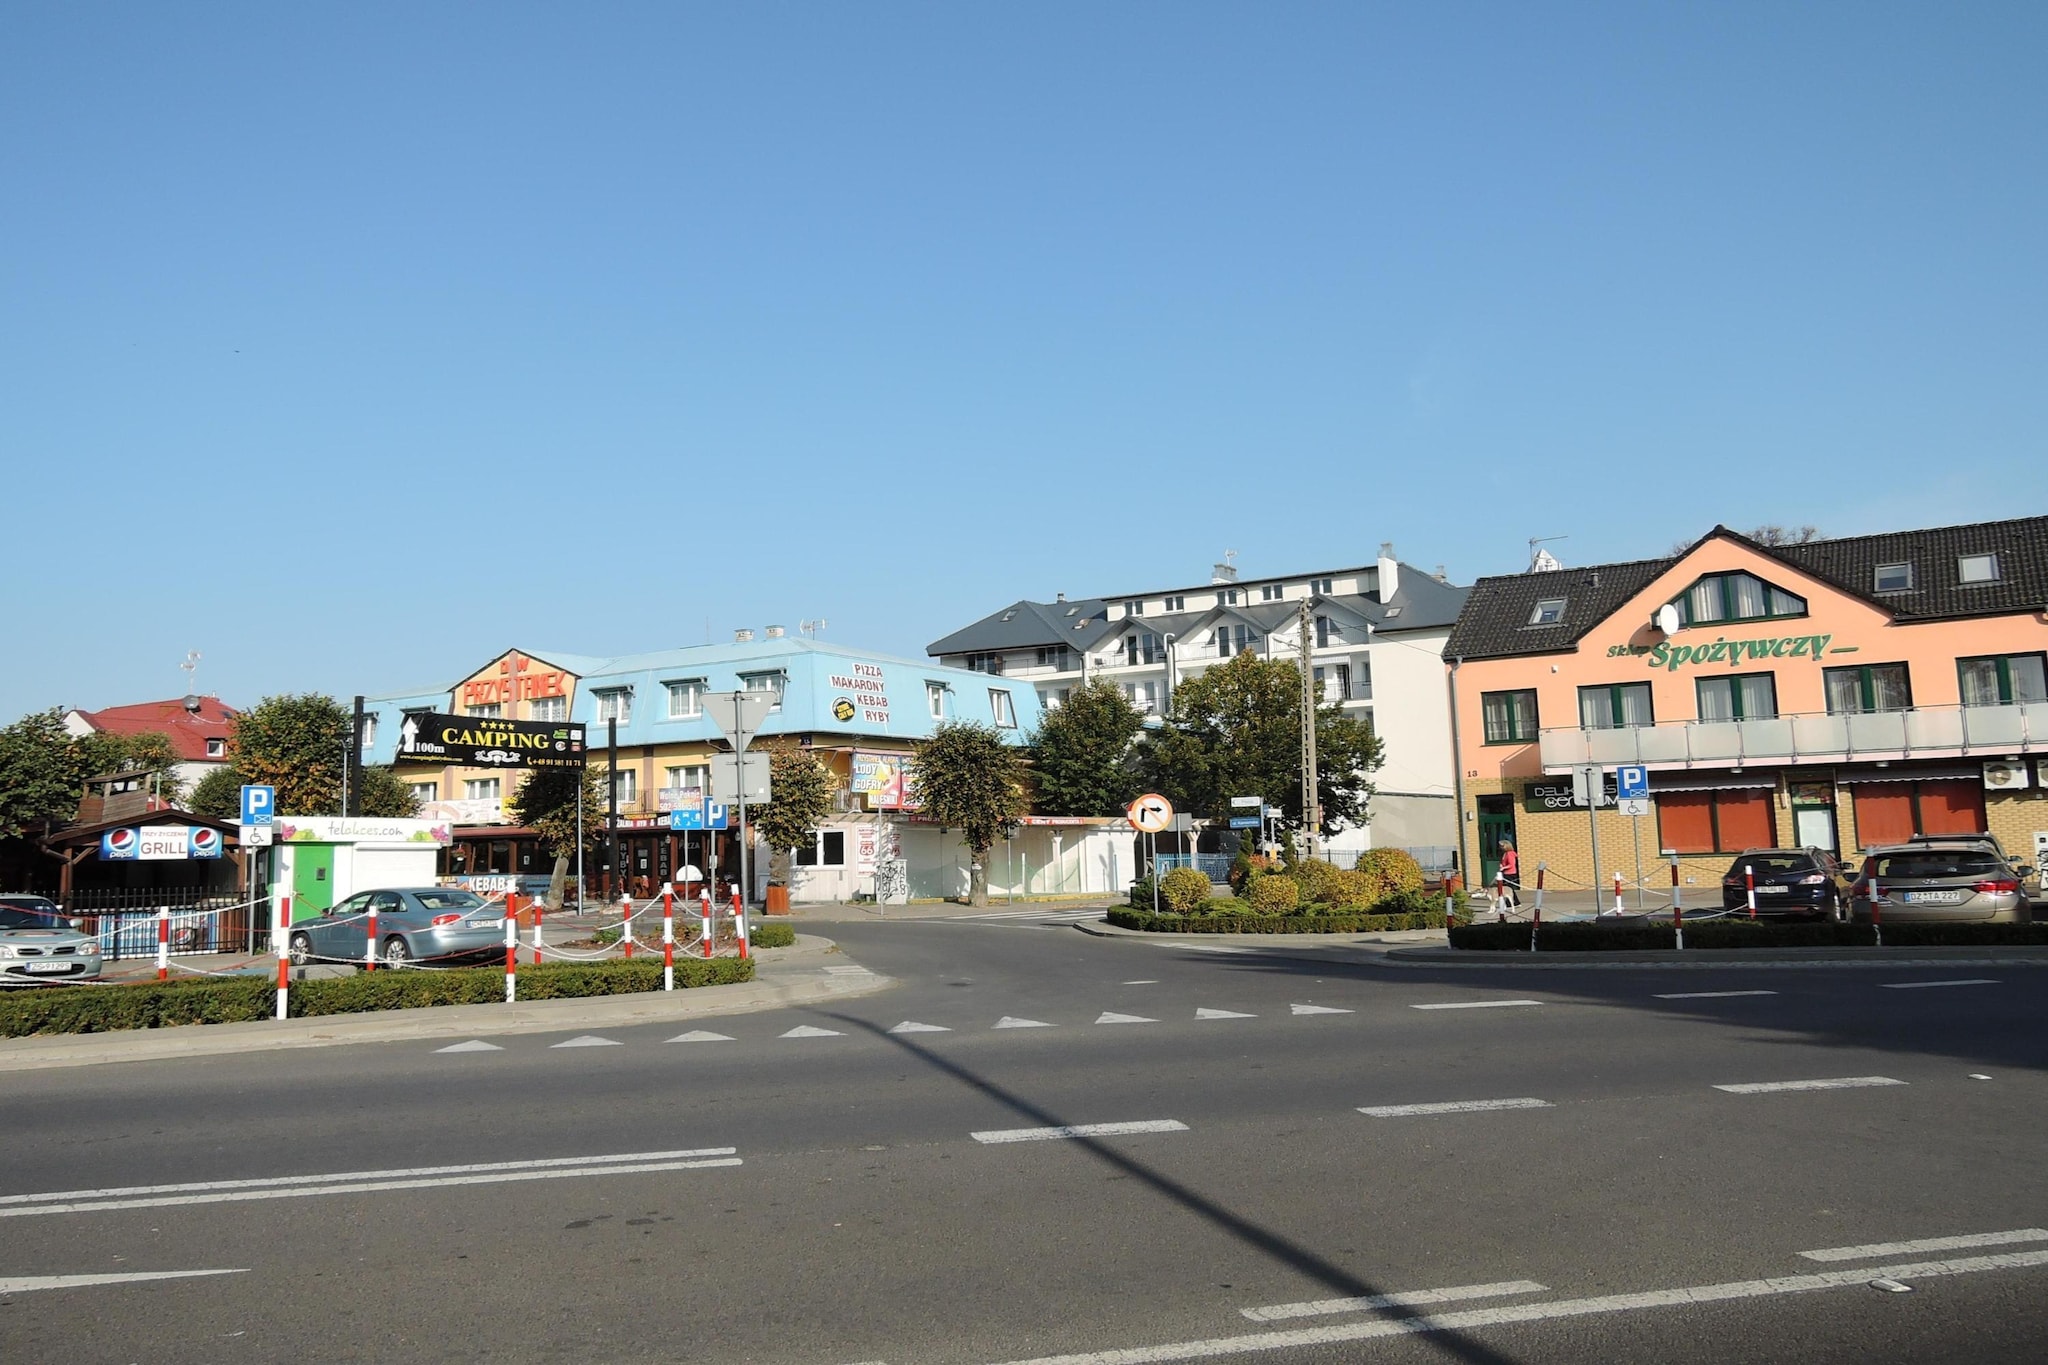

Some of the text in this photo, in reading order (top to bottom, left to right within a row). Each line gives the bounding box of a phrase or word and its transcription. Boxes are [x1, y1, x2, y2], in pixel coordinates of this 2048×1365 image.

[1648, 635, 1832, 671] Spożywczy
[854, 664, 883, 677] PIZZA
[463, 671, 567, 705] PRZYSTANEK
[831, 676, 885, 692] MAKARONY
[856, 694, 888, 707] KEBAB
[865, 710, 890, 722] RYBY
[441, 727, 550, 749] CAMPING
[415, 741, 446, 753] 100m
[855, 763, 877, 775] LODY
[1467, 770, 1478, 778] 13
[854, 779, 882, 790] GOFRY
[1623, 768, 1641, 790] P
[249, 789, 267, 815] P
[109, 851, 134, 859] pepsi
[140, 842, 186, 855] GRILL
[193, 849, 216, 858] pepsi
[860, 846, 874, 855] 66
[468, 877, 508, 892] KEBAB
